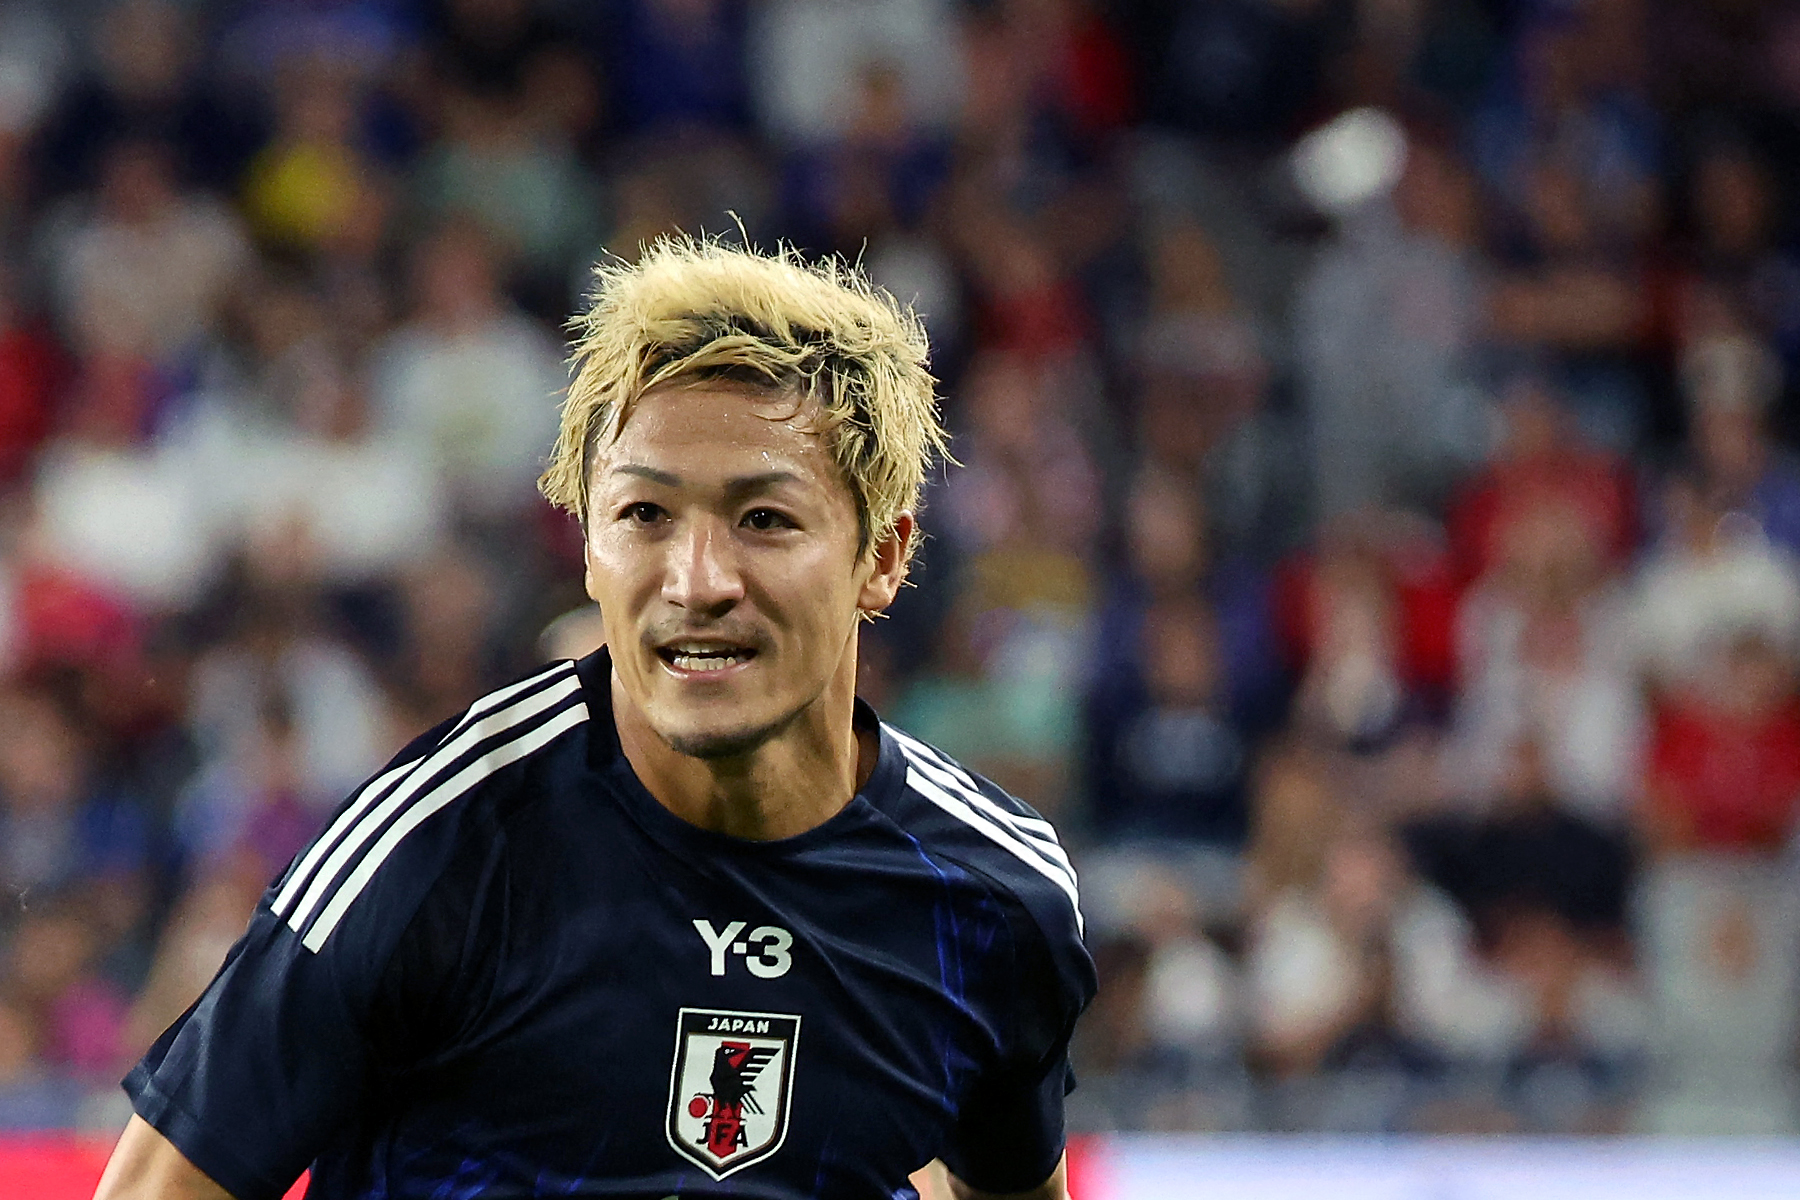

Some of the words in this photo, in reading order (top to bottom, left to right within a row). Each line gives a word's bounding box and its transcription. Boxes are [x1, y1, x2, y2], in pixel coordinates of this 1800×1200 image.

[692, 919, 794, 979] Y-3
[707, 1017, 770, 1034] JAPAN
[696, 1121, 749, 1148] JFA
